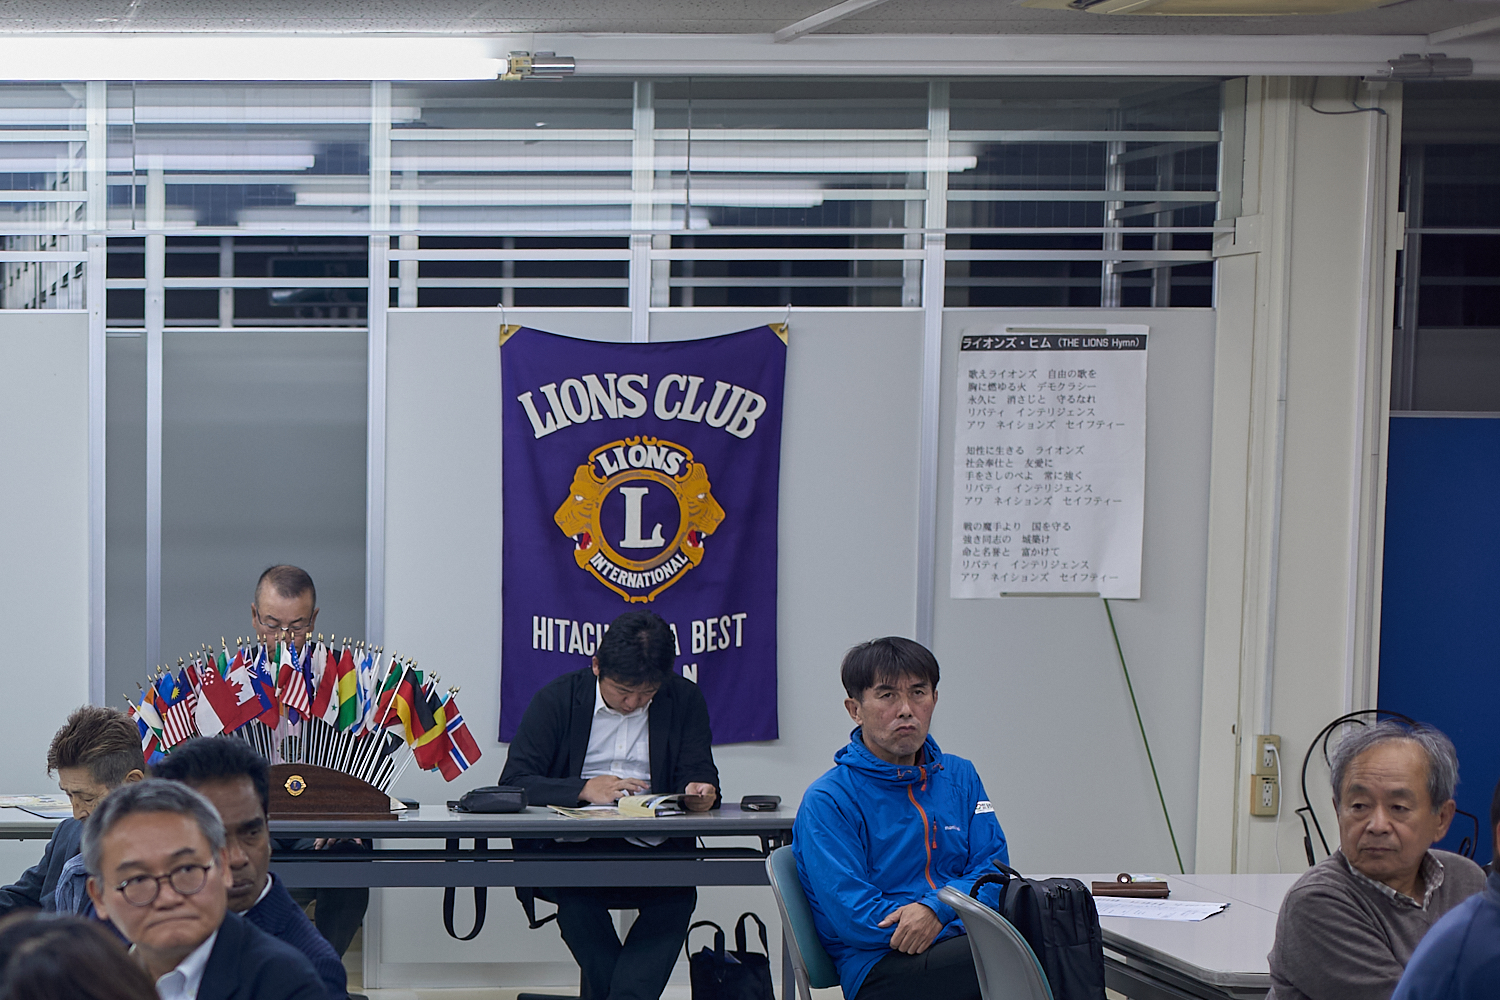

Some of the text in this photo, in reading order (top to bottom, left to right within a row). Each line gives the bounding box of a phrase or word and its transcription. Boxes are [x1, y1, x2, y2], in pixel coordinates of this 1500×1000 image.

[1083, 338, 1108, 348] LIONS
[969, 369, 1097, 379] 歌えライオンズ 自由の歌を
[968, 381, 1097, 392] 胸に燃ゆる火 デモクラシー
[967, 394, 1096, 405] 永久に 消さじと 守るなれ
[517, 373, 767, 439] LIONS CLUB
[1017, 407, 1095, 417] インテリジェンス
[967, 420, 1125, 430] アワ ネイションズ セイフティー
[966, 445, 1085, 455] 知性に生きる ライオンズ
[596, 444, 685, 476] LIONS
[966, 458, 1053, 468] 社会奉仕と 友愛に
[966, 471, 1082, 481] 手をさしのべよ 常に強く
[1014, 483, 1092, 493] インテリジェンス
[965, 496, 1122, 506] アワ ネイションズ セイフティー
[619, 486, 665, 548] L
[963, 521, 1071, 532] 戦の魔手より 国を守る
[963, 534, 1011, 545] 強き同志の
[962, 547, 1060, 557] 命と名誉と 富かけて
[1011, 560, 1089, 570] インテリジェンス
[589, 552, 688, 589] INTERNATIONAL
[961, 572, 1118, 582] アワ ネイションズ セイフティー
[692, 612, 747, 655] BEST
